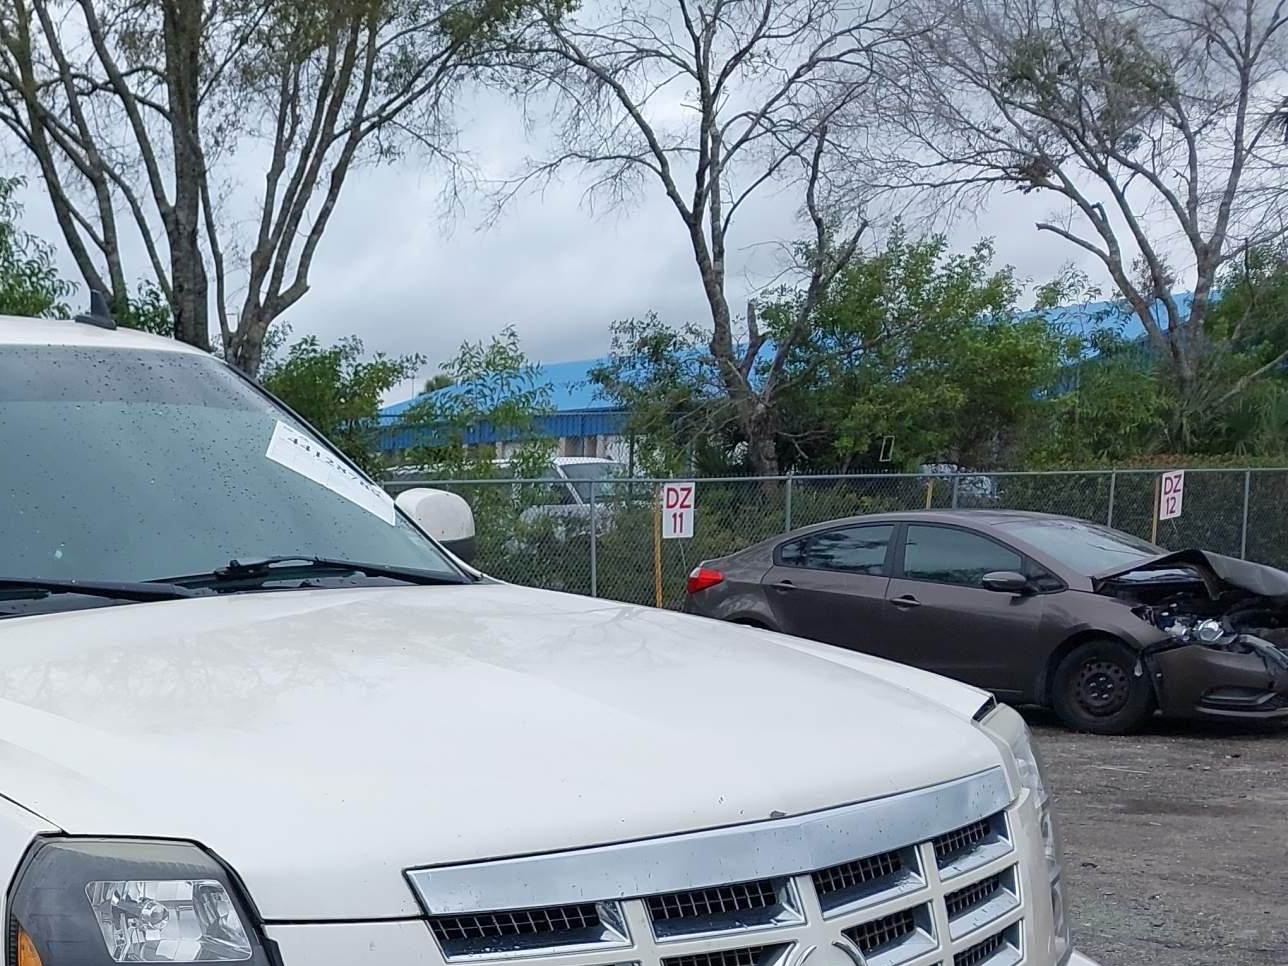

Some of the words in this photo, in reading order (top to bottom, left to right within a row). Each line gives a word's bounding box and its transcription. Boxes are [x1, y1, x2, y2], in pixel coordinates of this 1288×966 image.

[1164, 474, 1182, 495] DZ
[666, 487, 692, 508] DZ
[1166, 496, 1176, 515] 12
[672, 512, 683, 533] 11
